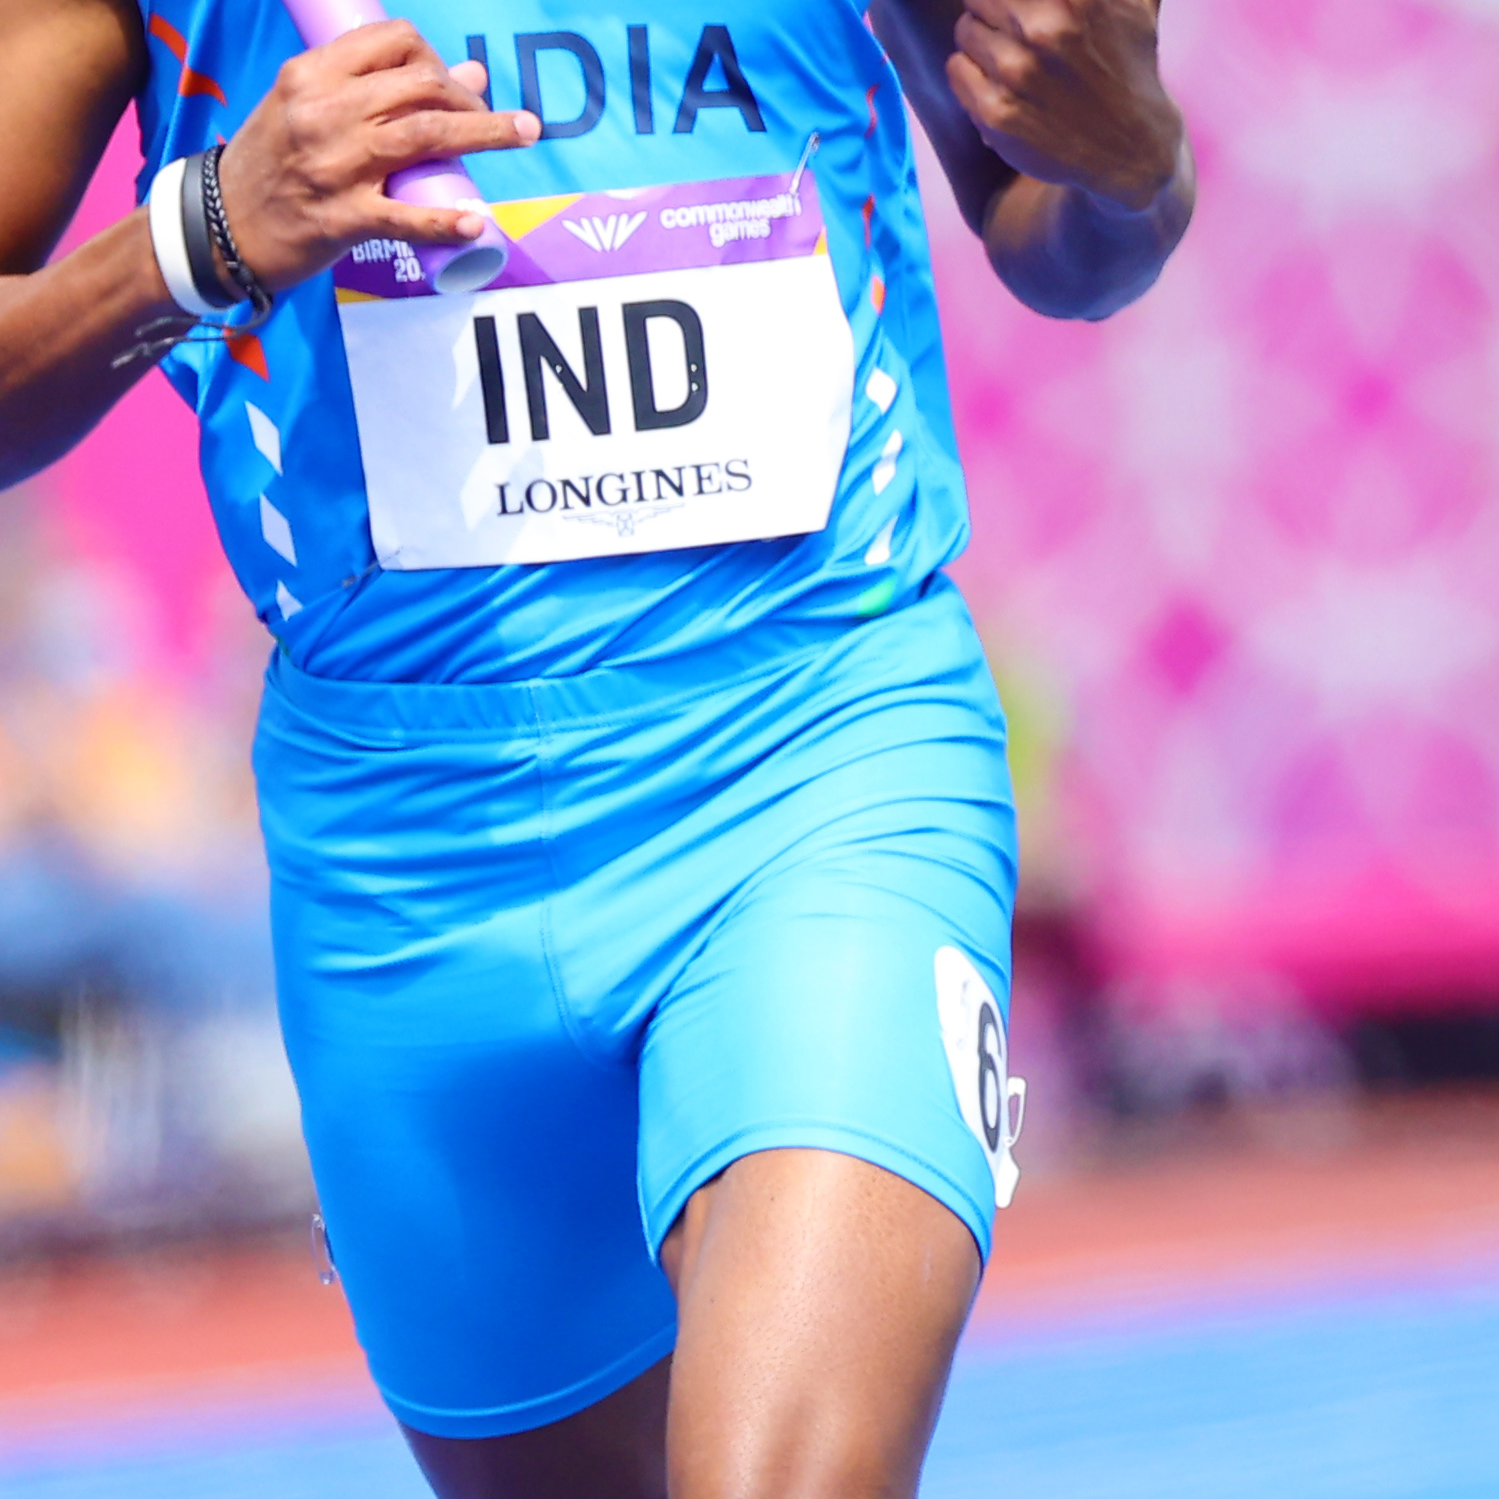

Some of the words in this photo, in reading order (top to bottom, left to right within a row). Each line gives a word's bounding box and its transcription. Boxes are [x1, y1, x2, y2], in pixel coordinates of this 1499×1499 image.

[473, 299, 709, 445] IND
[497, 458, 753, 517] LONGINES
[978, 1001, 1002, 1153] 6
